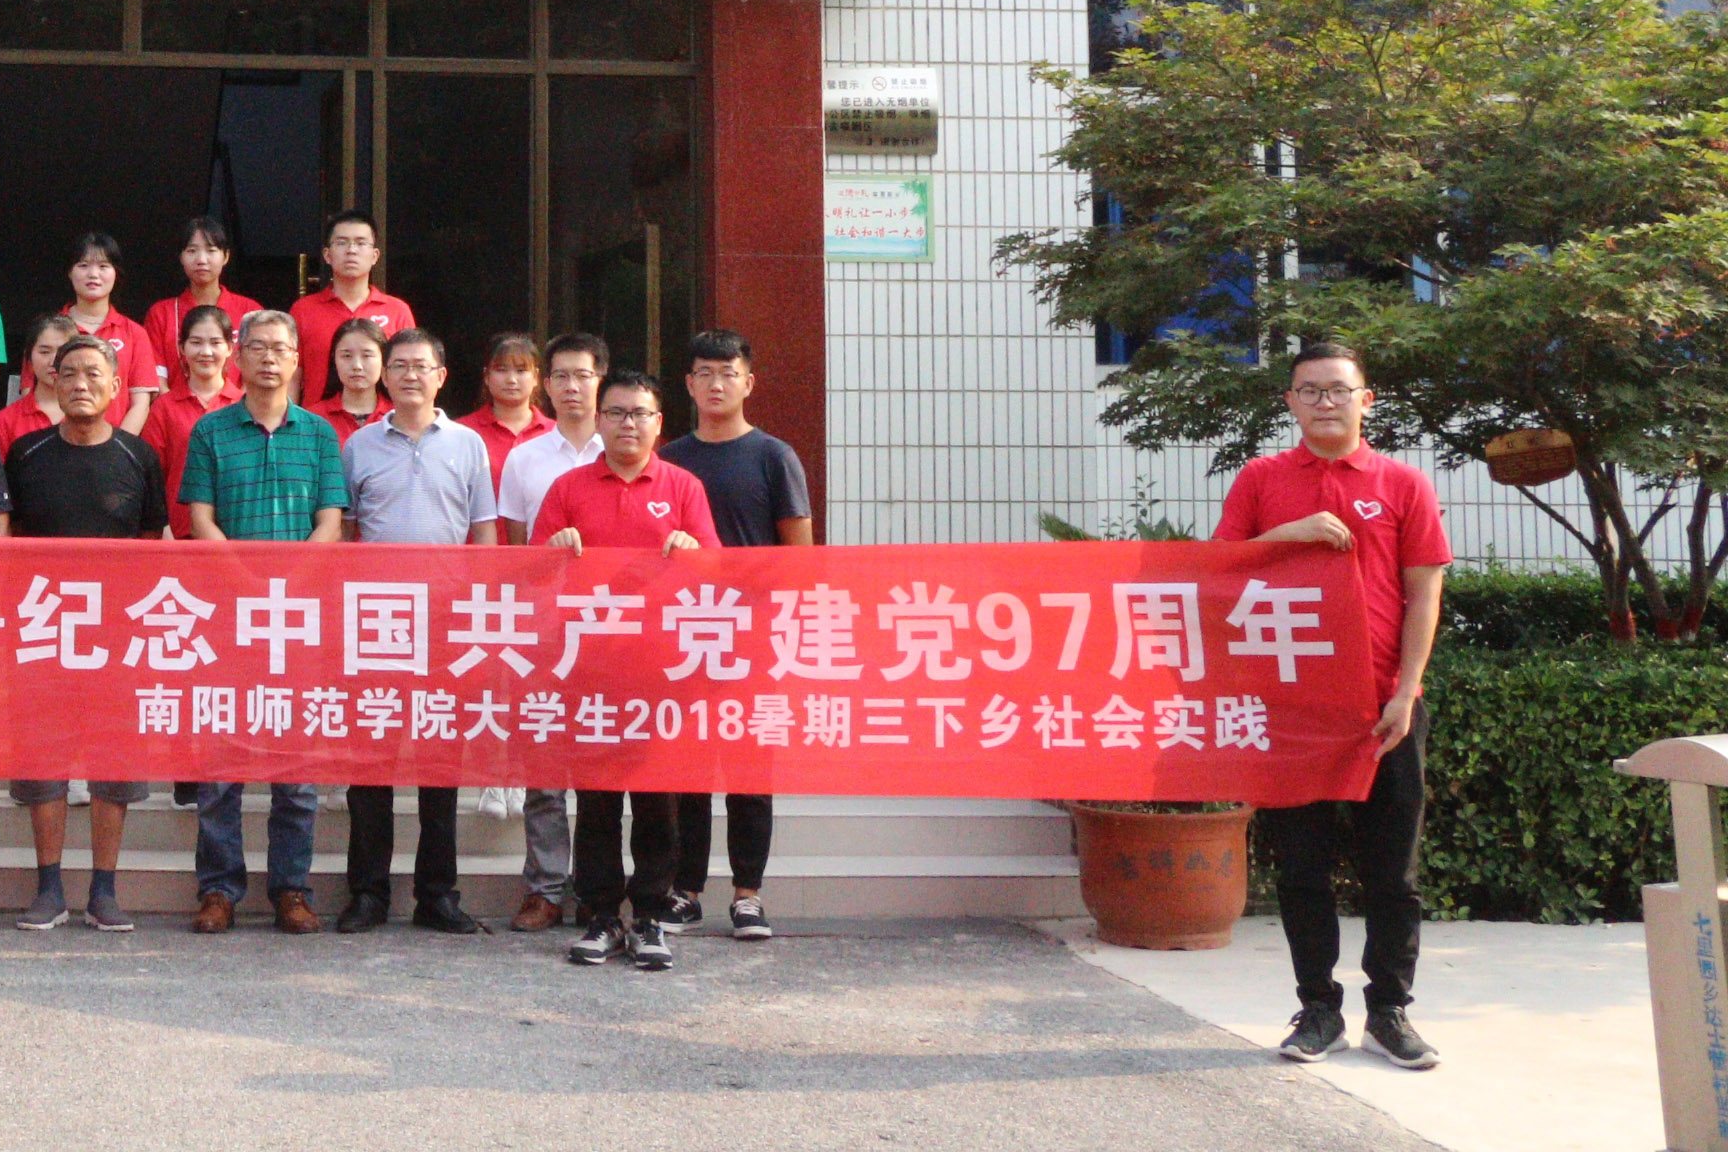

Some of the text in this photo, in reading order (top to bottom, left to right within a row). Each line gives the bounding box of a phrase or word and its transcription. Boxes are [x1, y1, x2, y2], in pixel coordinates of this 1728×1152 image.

[823, 79, 860, 90] 馨提示
[840, 97, 930, 108] 您已进入无烟单位
[825, 207, 910, 220] 明礼让一小步
[835, 226, 926, 239] 社会和谐一大步
[135, 682, 1271, 753] 南阳师范学院大学生2018暑期三下乡社会实践
